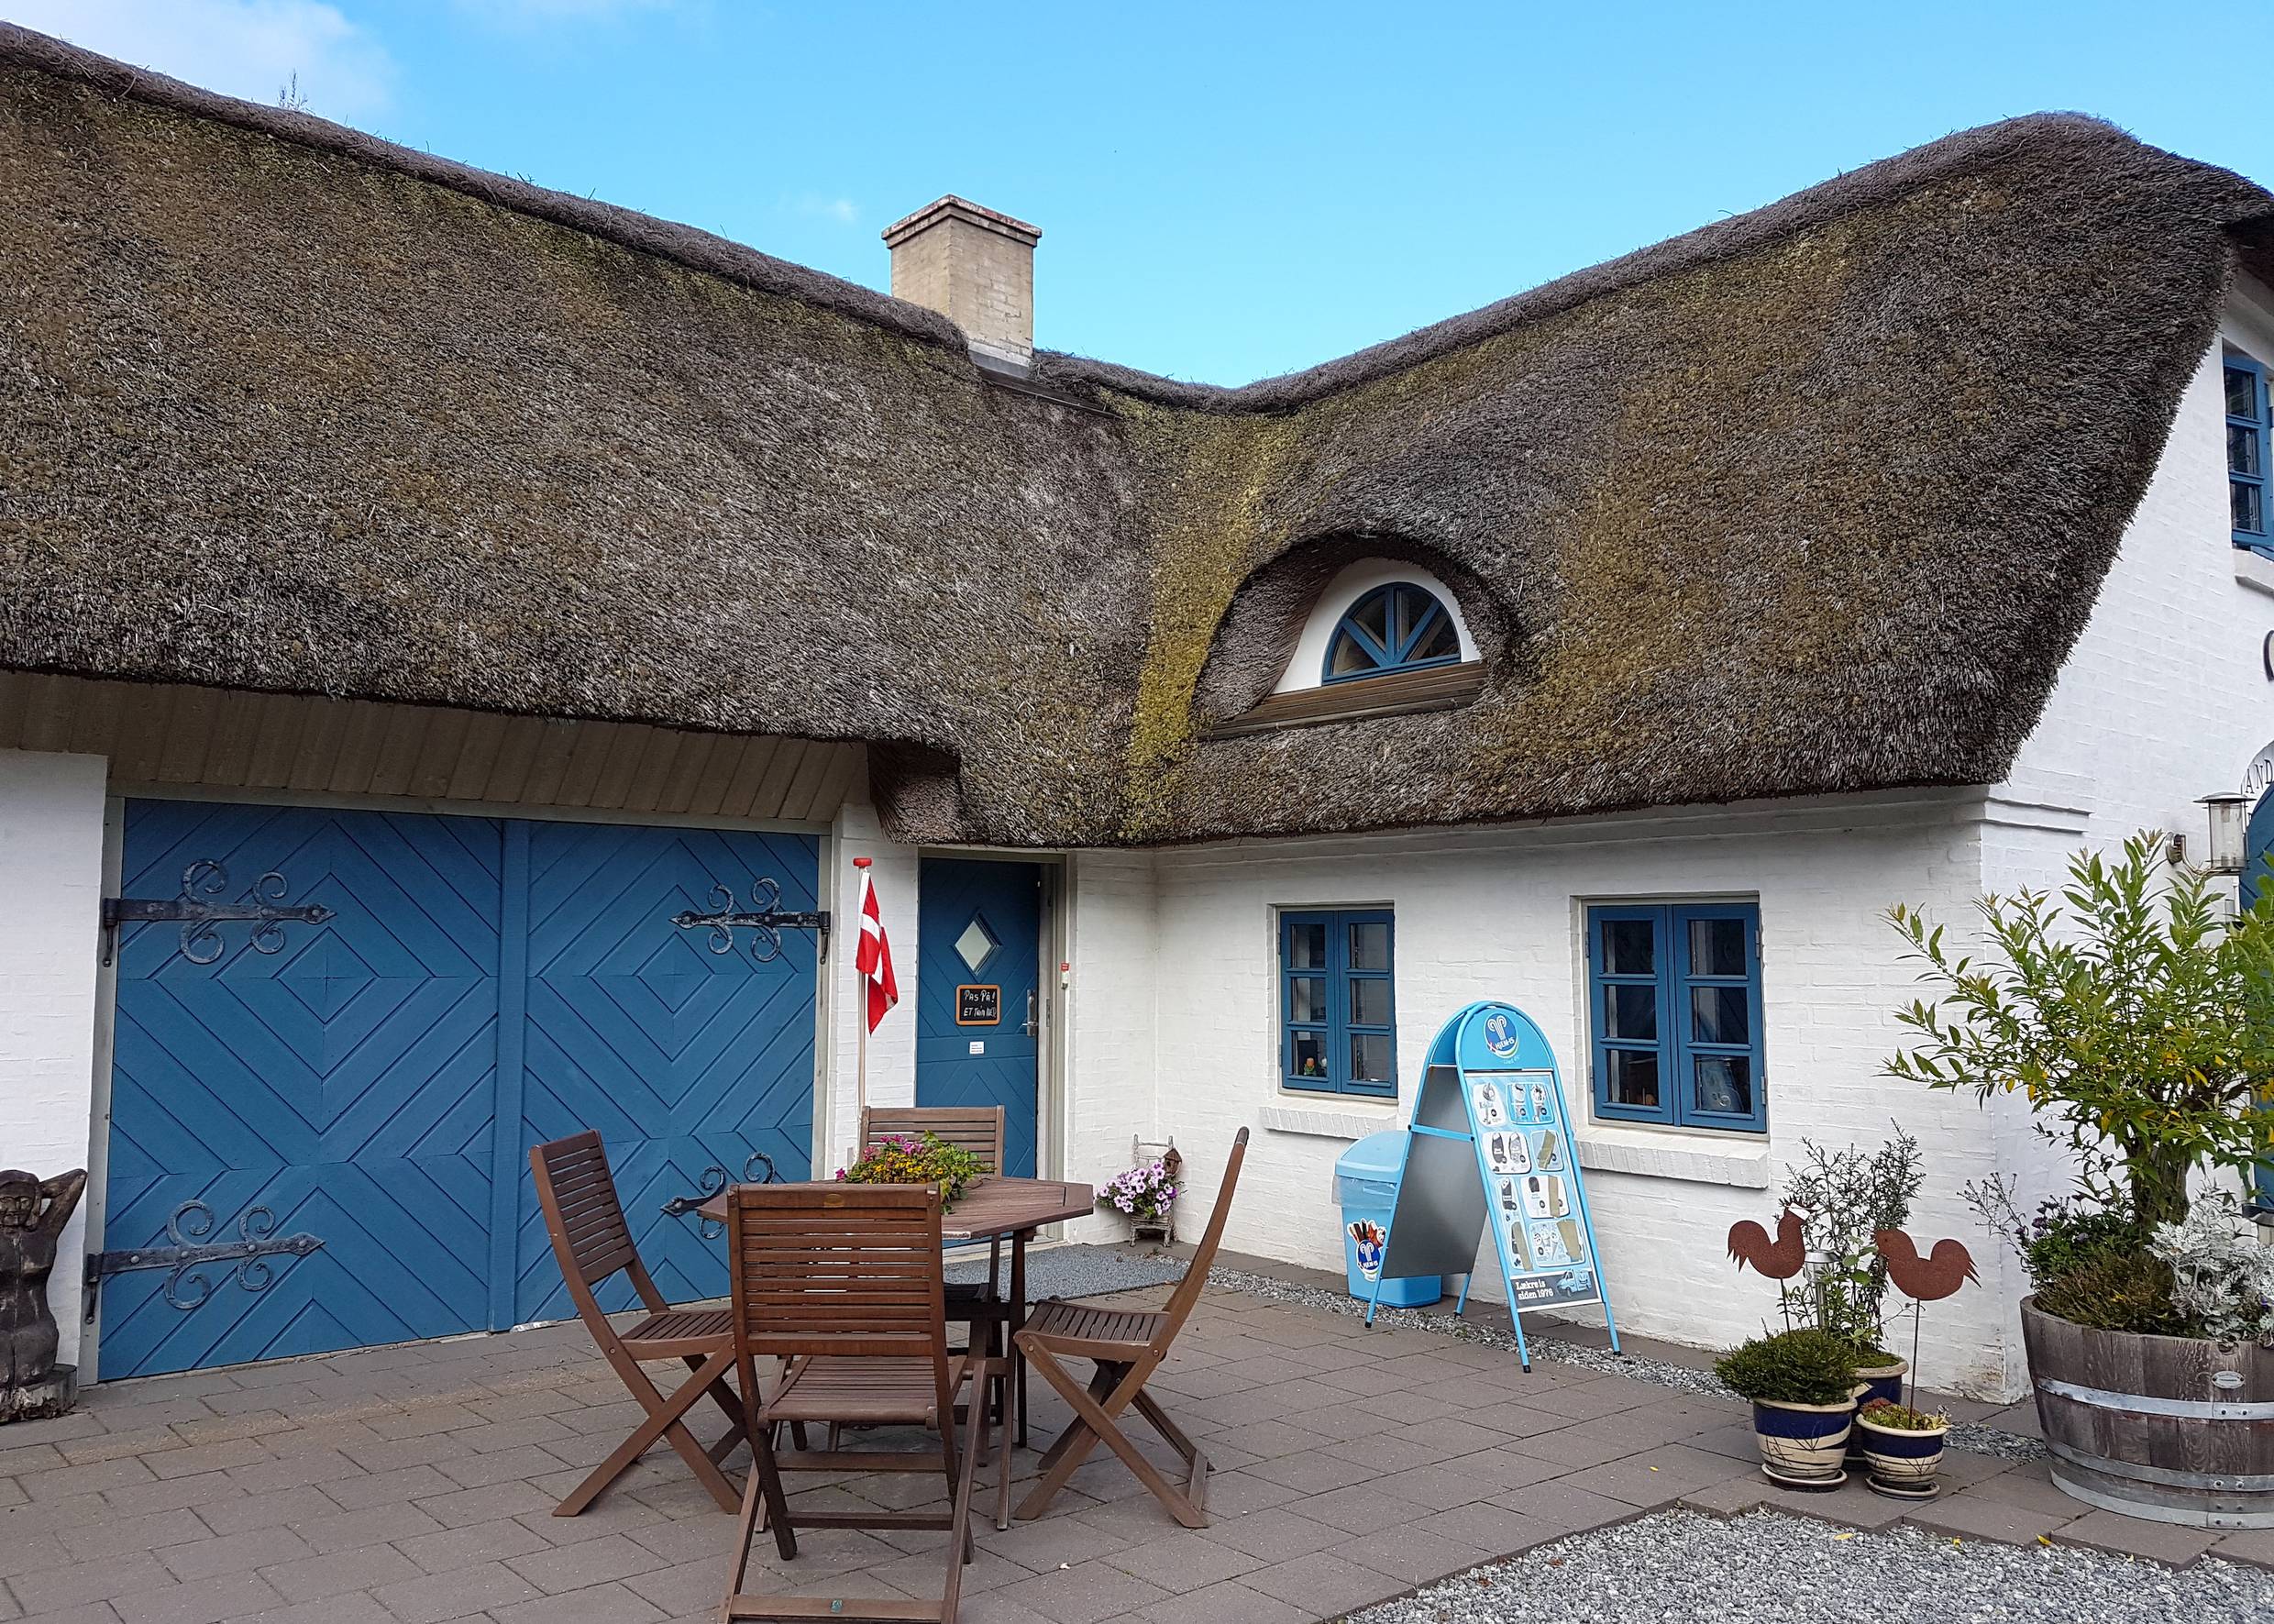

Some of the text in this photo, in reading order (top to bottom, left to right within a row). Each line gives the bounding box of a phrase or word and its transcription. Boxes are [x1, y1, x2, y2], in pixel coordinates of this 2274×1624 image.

[964, 989, 979, 1001] PAS
[964, 1007, 973, 1017] ET
[1518, 1288, 1553, 1300] siden 1976
